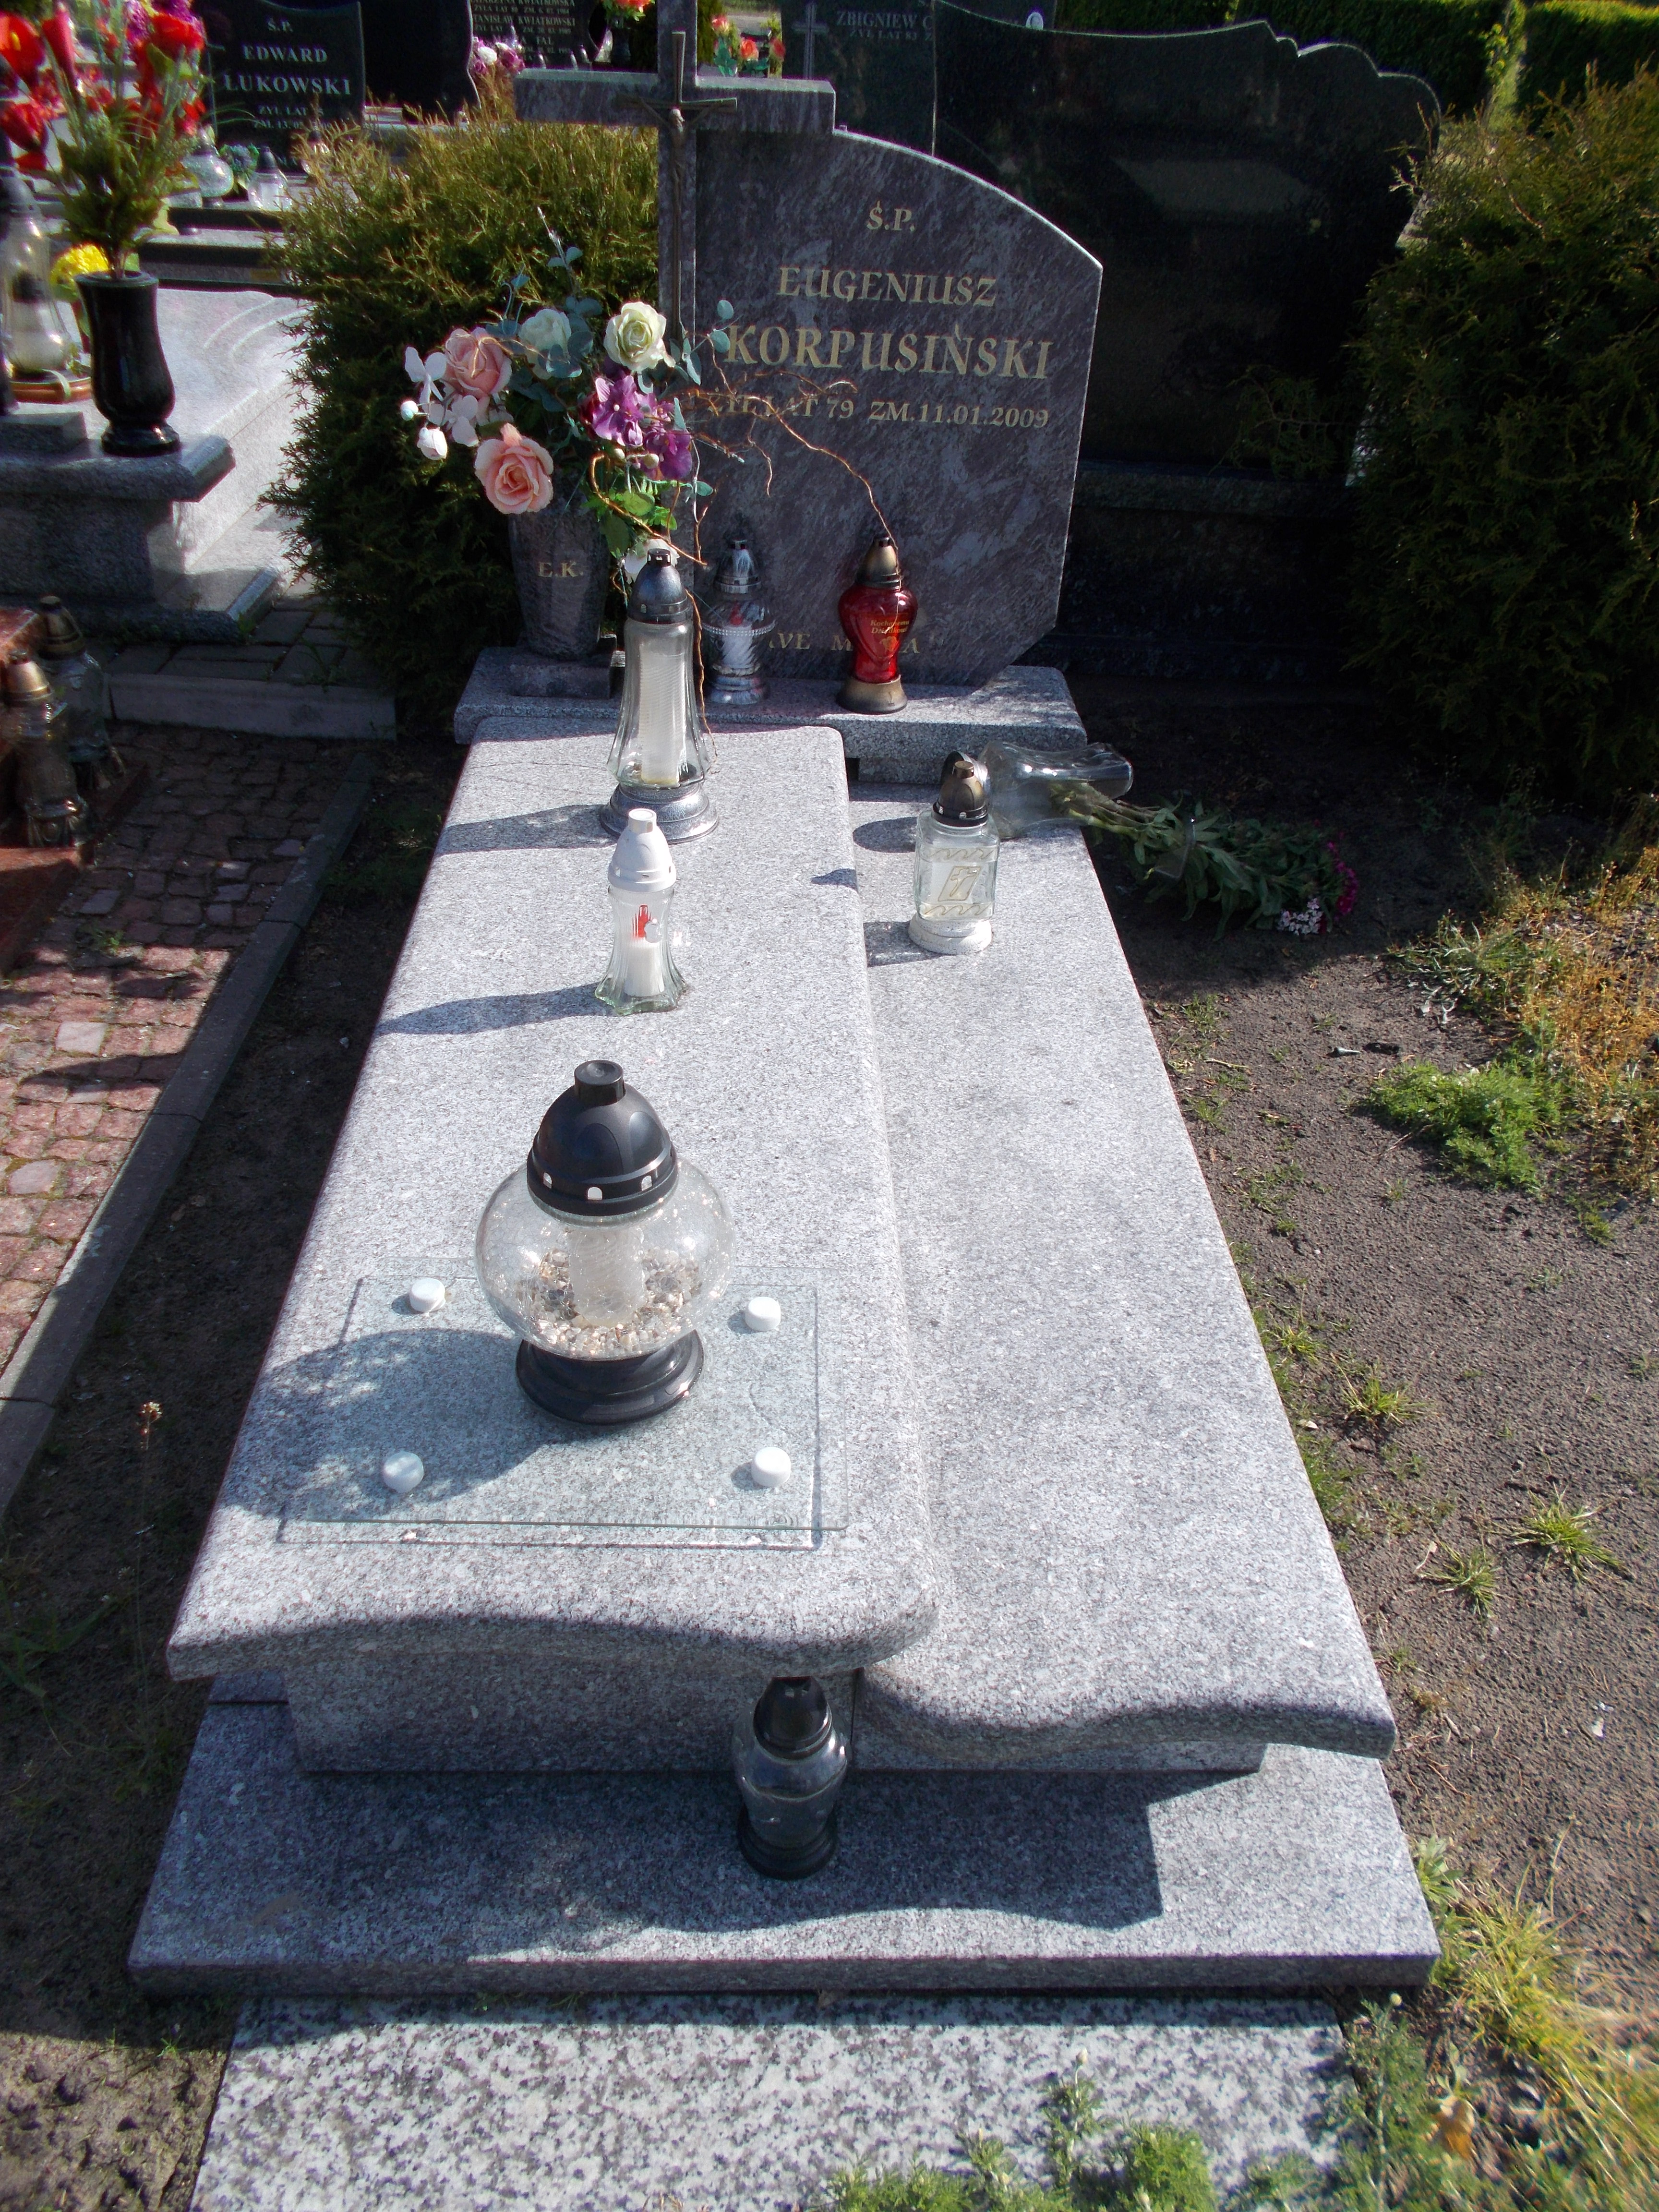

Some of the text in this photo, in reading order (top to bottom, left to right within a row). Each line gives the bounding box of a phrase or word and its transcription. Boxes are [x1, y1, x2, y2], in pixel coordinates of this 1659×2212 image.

[836, 11, 917, 29] ZBIGNIEW
[242, 45, 327, 63] EDWARD
[776, 266, 997, 307] EUGENIUSZ
[724, 323, 1054, 380] KORPUSIŃSKI
[827, 398, 854, 420] 79
